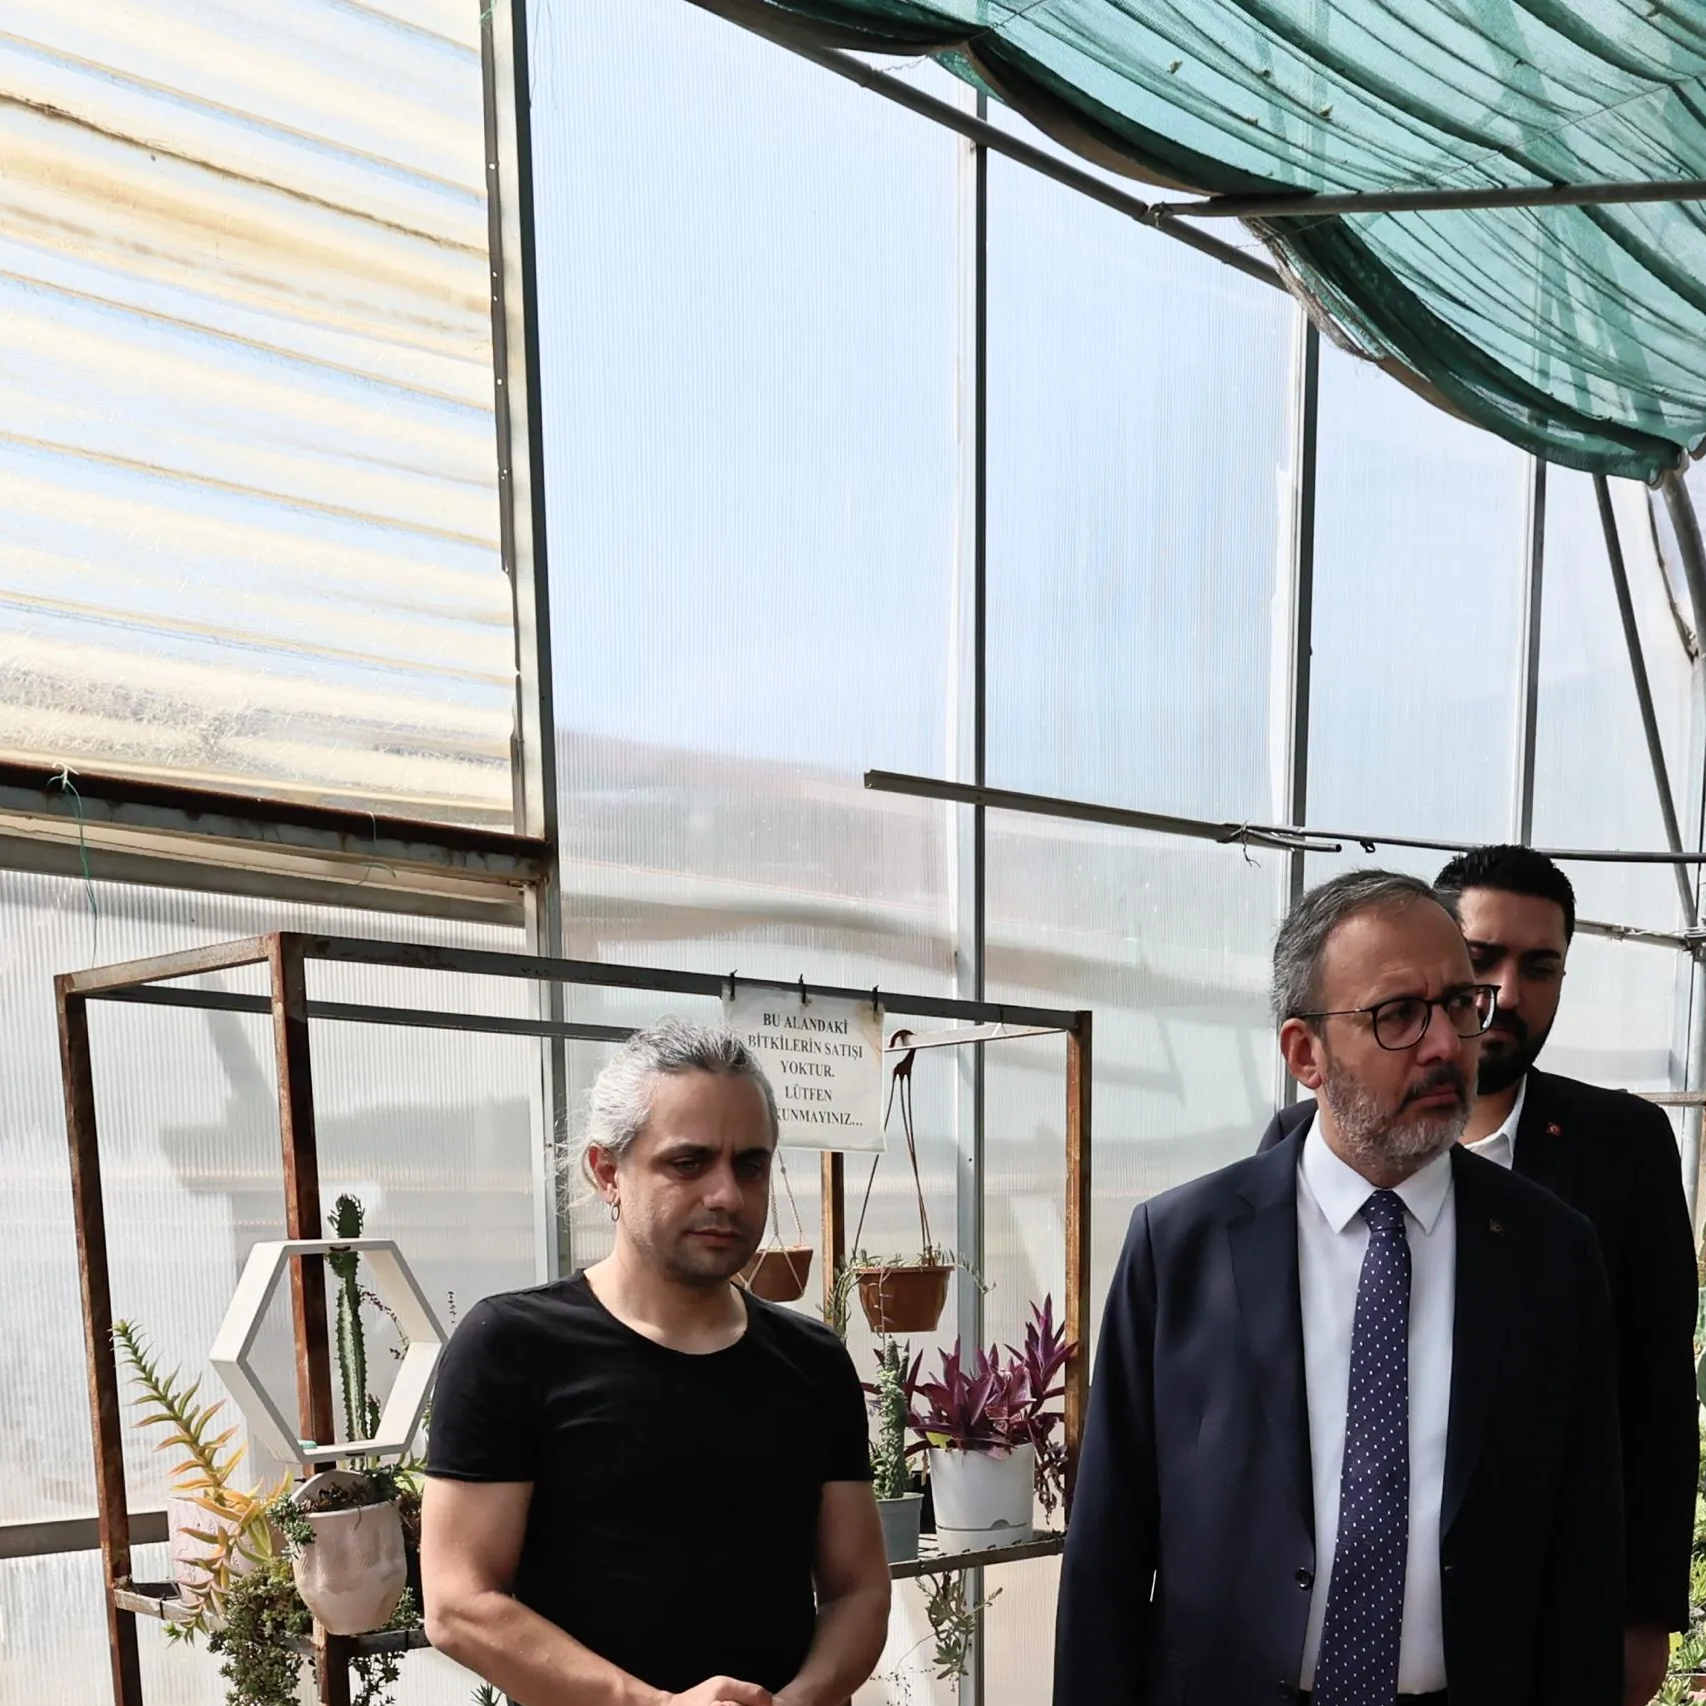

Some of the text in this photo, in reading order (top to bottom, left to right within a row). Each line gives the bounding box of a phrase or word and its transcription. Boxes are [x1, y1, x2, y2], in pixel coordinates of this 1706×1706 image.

[763, 1013, 848, 1035] BU ALANDAKİ
[748, 1032, 863, 1060] BİTKİLERİN SATIŞI
[781, 1060, 835, 1078] YOKTUR.
[785, 1084, 833, 1102] LÜTFEN
